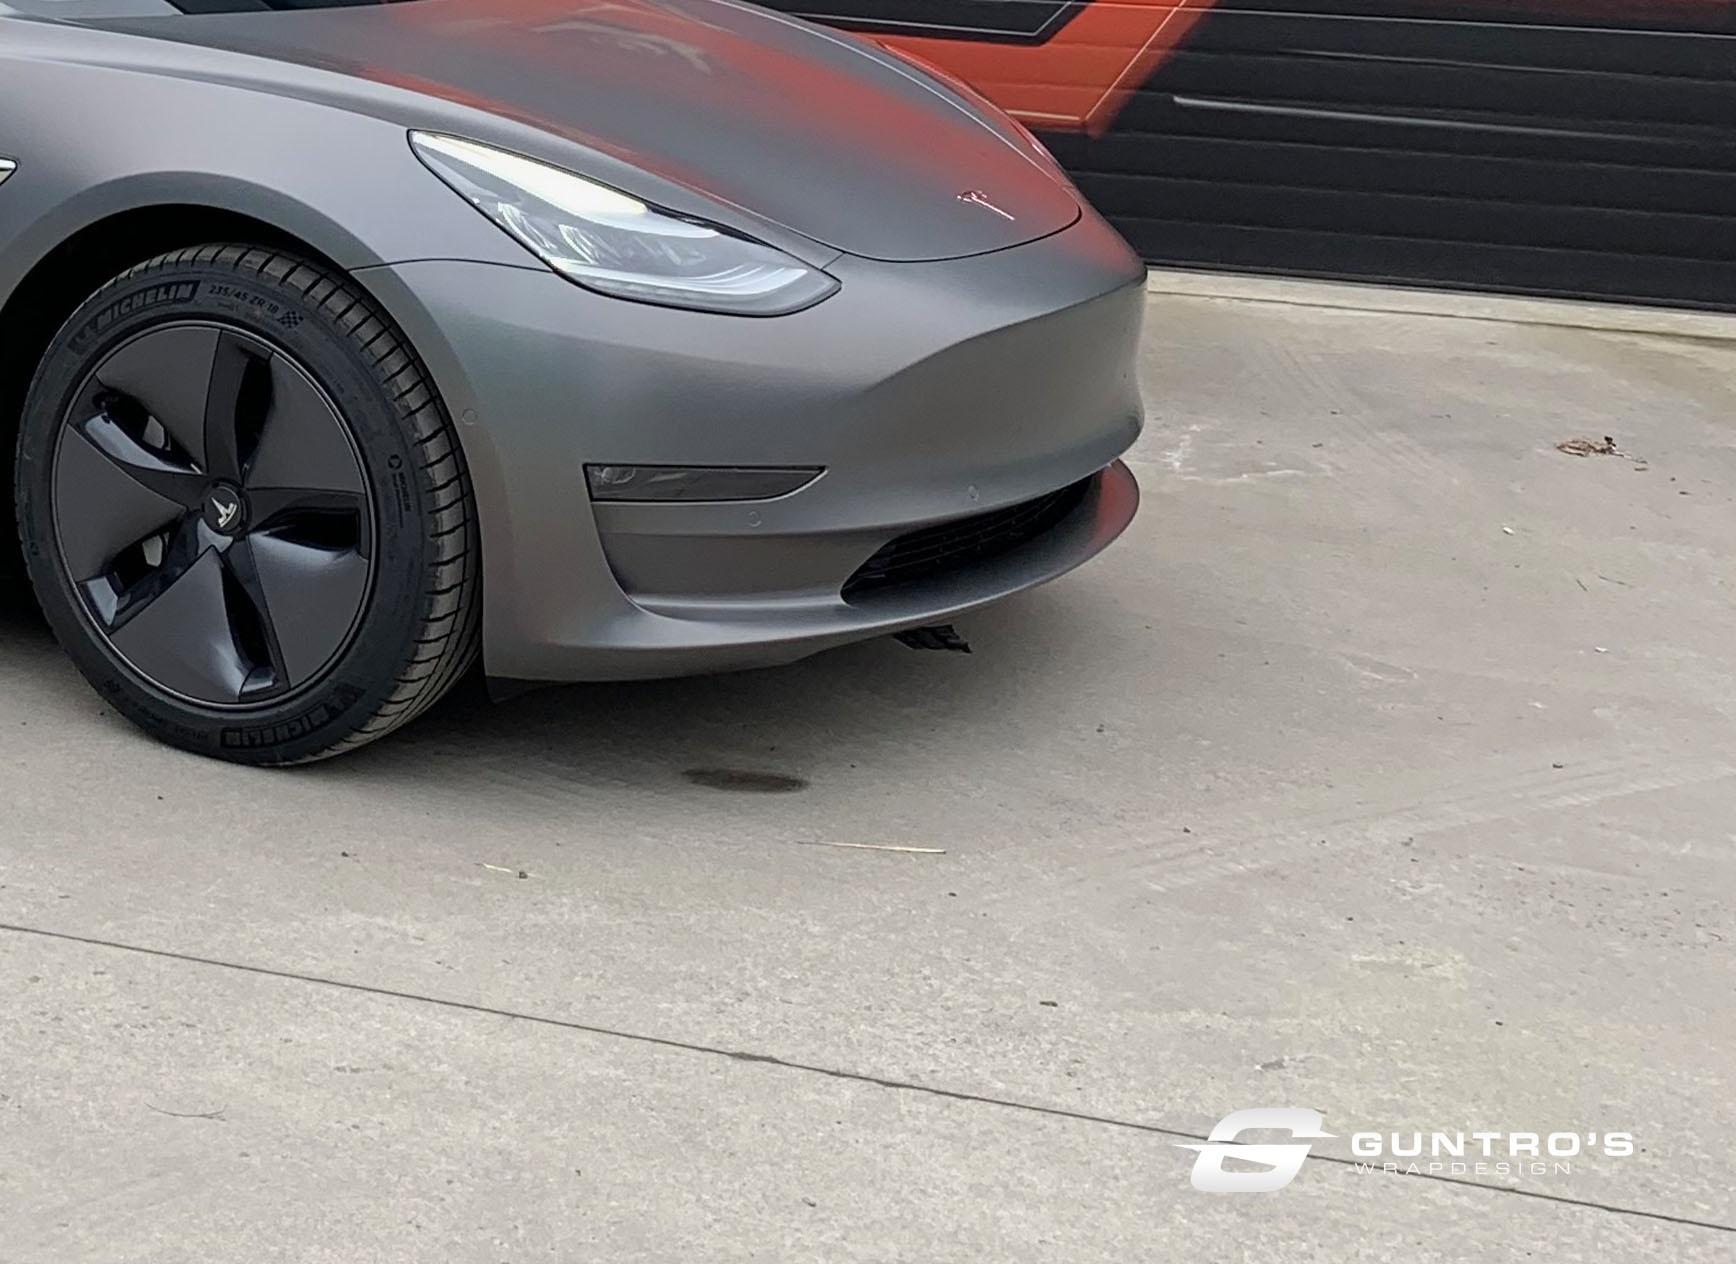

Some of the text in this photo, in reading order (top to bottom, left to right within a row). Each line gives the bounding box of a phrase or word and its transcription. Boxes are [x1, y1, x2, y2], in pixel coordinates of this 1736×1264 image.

[95, 282, 196, 331] MICHELIN
[208, 284, 249, 302] 235/45
[249, 295, 266, 309] ZR
[267, 303, 279, 314] 18
[224, 706, 330, 747] MICHELIN
